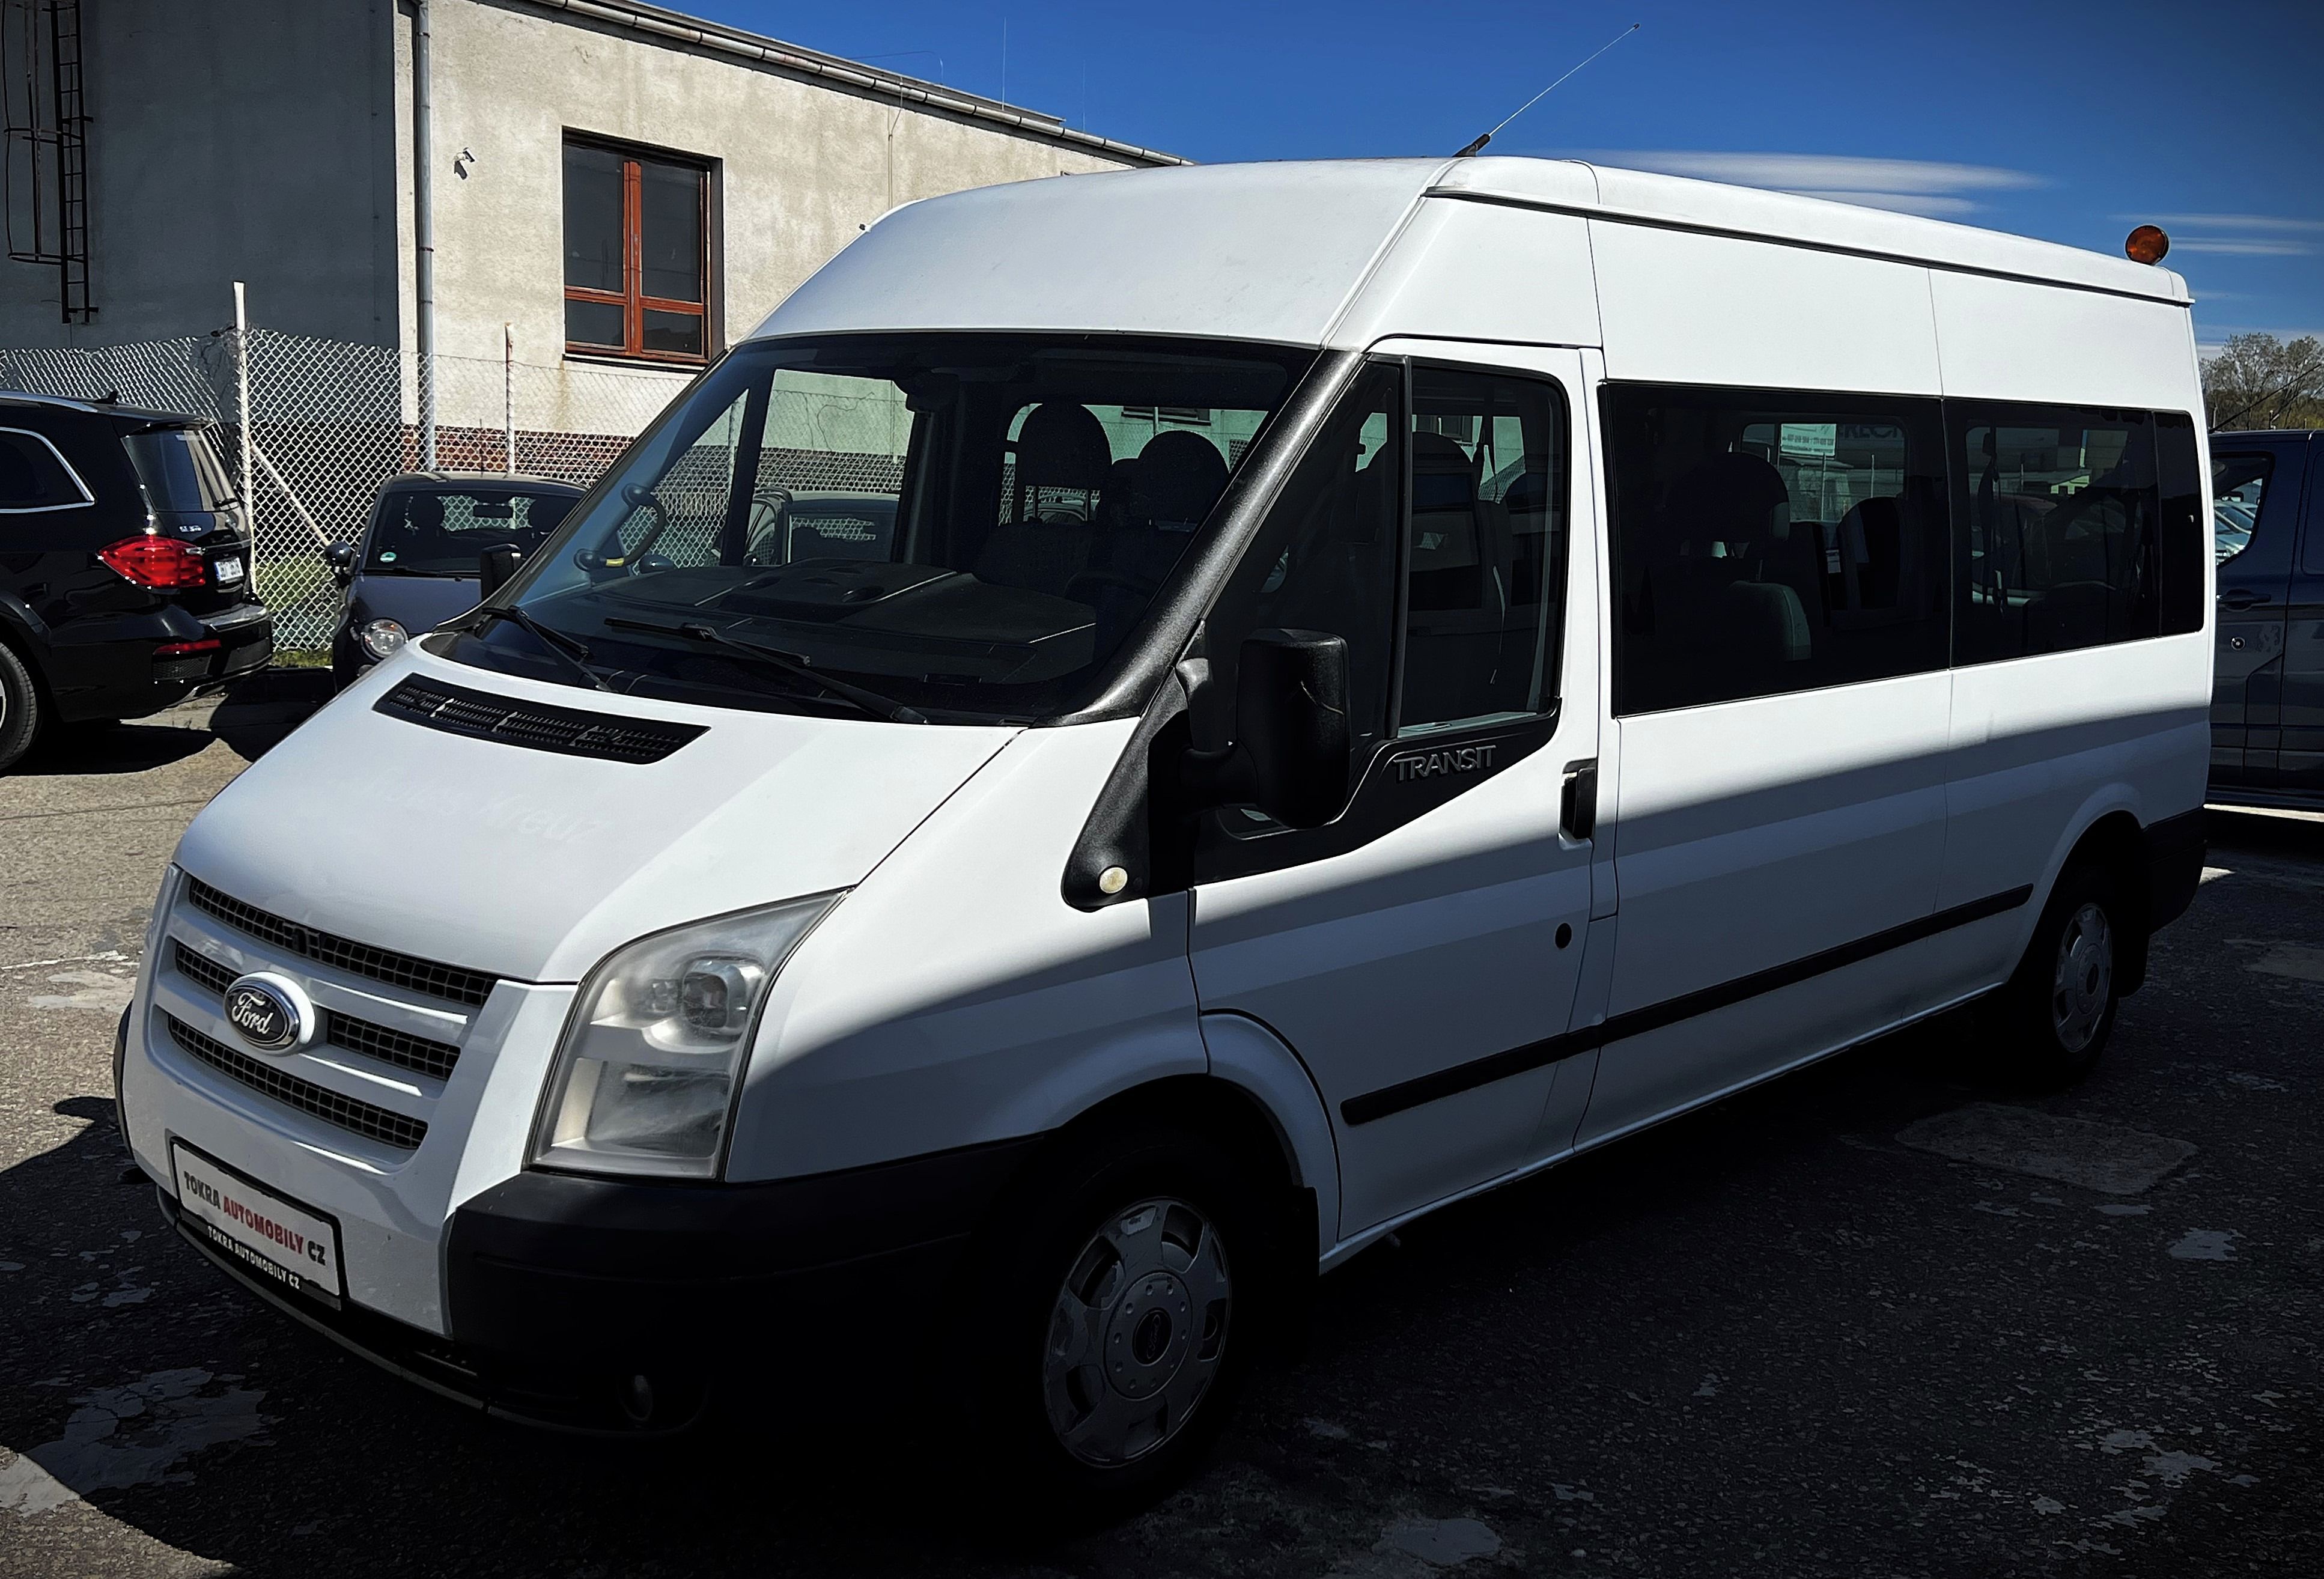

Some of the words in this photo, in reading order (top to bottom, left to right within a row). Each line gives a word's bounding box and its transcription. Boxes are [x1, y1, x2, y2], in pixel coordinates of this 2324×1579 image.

[1393, 745, 1496, 780] TRANSIT
[231, 992, 274, 1034] Ford
[184, 1170, 221, 1209] TOKRA
[223, 1196, 305, 1255] AUTOMOBILY
[307, 1241, 326, 1266] CZ
[207, 1226, 233, 1252] TOKRA
[234, 1246, 287, 1283] AUTOMOBILY
[288, 1274, 300, 1289] CZ
